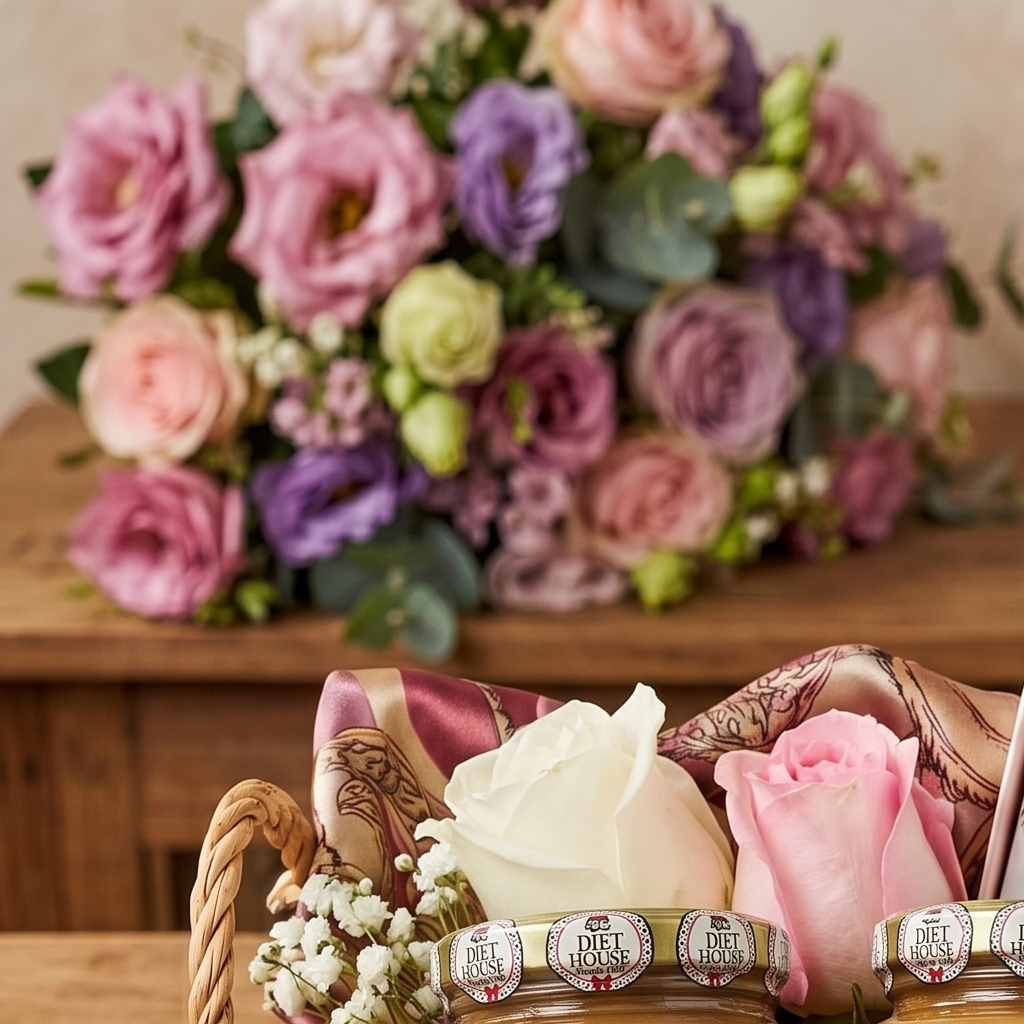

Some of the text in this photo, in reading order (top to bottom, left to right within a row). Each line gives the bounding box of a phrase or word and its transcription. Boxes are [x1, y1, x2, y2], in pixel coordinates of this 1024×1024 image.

[577, 933, 624, 952] DIET
[706, 932, 740, 949] DIET
[916, 925, 950, 944] DIET
[466, 942, 498, 964] DIET
[569, 950, 630, 967] HOUSE
[698, 949, 744, 965] HOUSE
[910, 942, 954, 960] HOUSE
[461, 958, 504, 980] HOUSE
